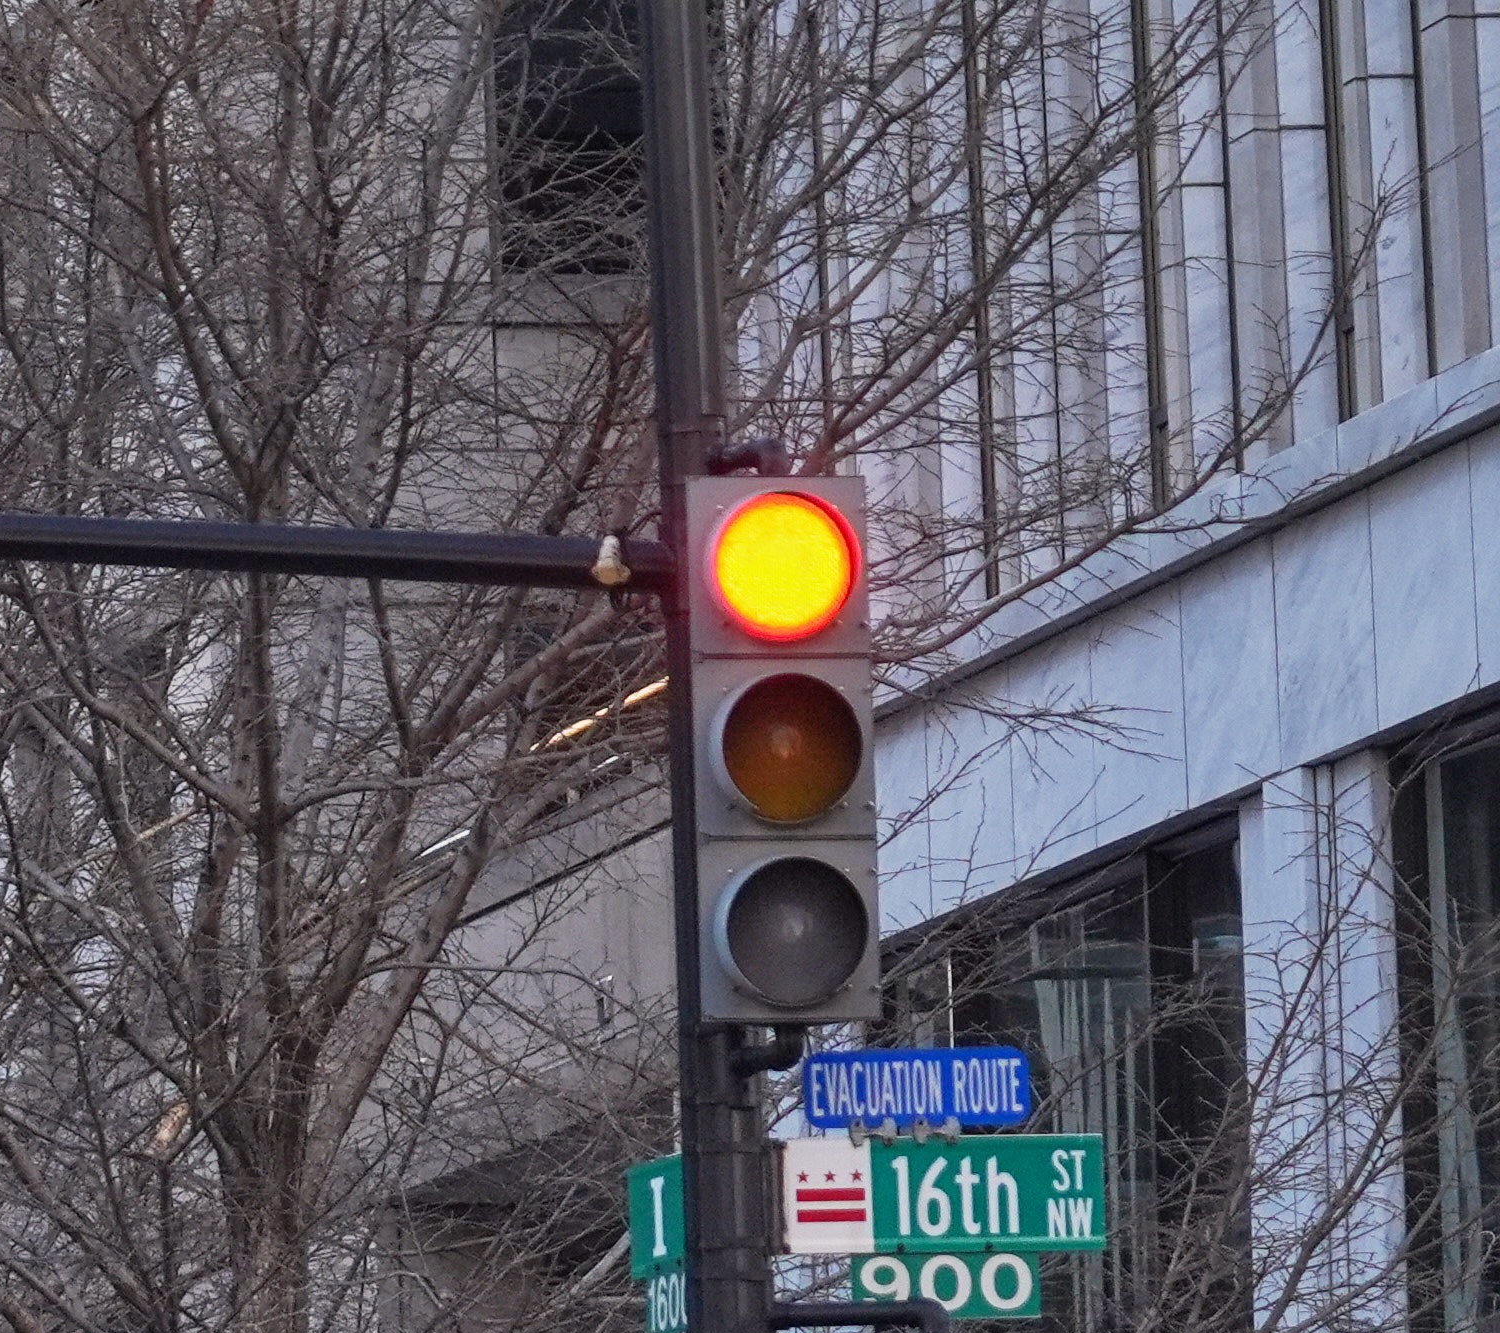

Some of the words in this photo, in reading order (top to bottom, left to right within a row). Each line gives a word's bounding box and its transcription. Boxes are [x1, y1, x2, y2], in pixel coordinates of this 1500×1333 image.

[810, 1060, 942, 1117] EVACUATION
[953, 1057, 1021, 1113] ROUTE
[650, 1175, 668, 1257] I
[891, 1155, 1019, 1236] 16th
[1051, 1150, 1086, 1191] ST
[1047, 1198, 1093, 1238] NW
[860, 1253, 1033, 1311] 900
